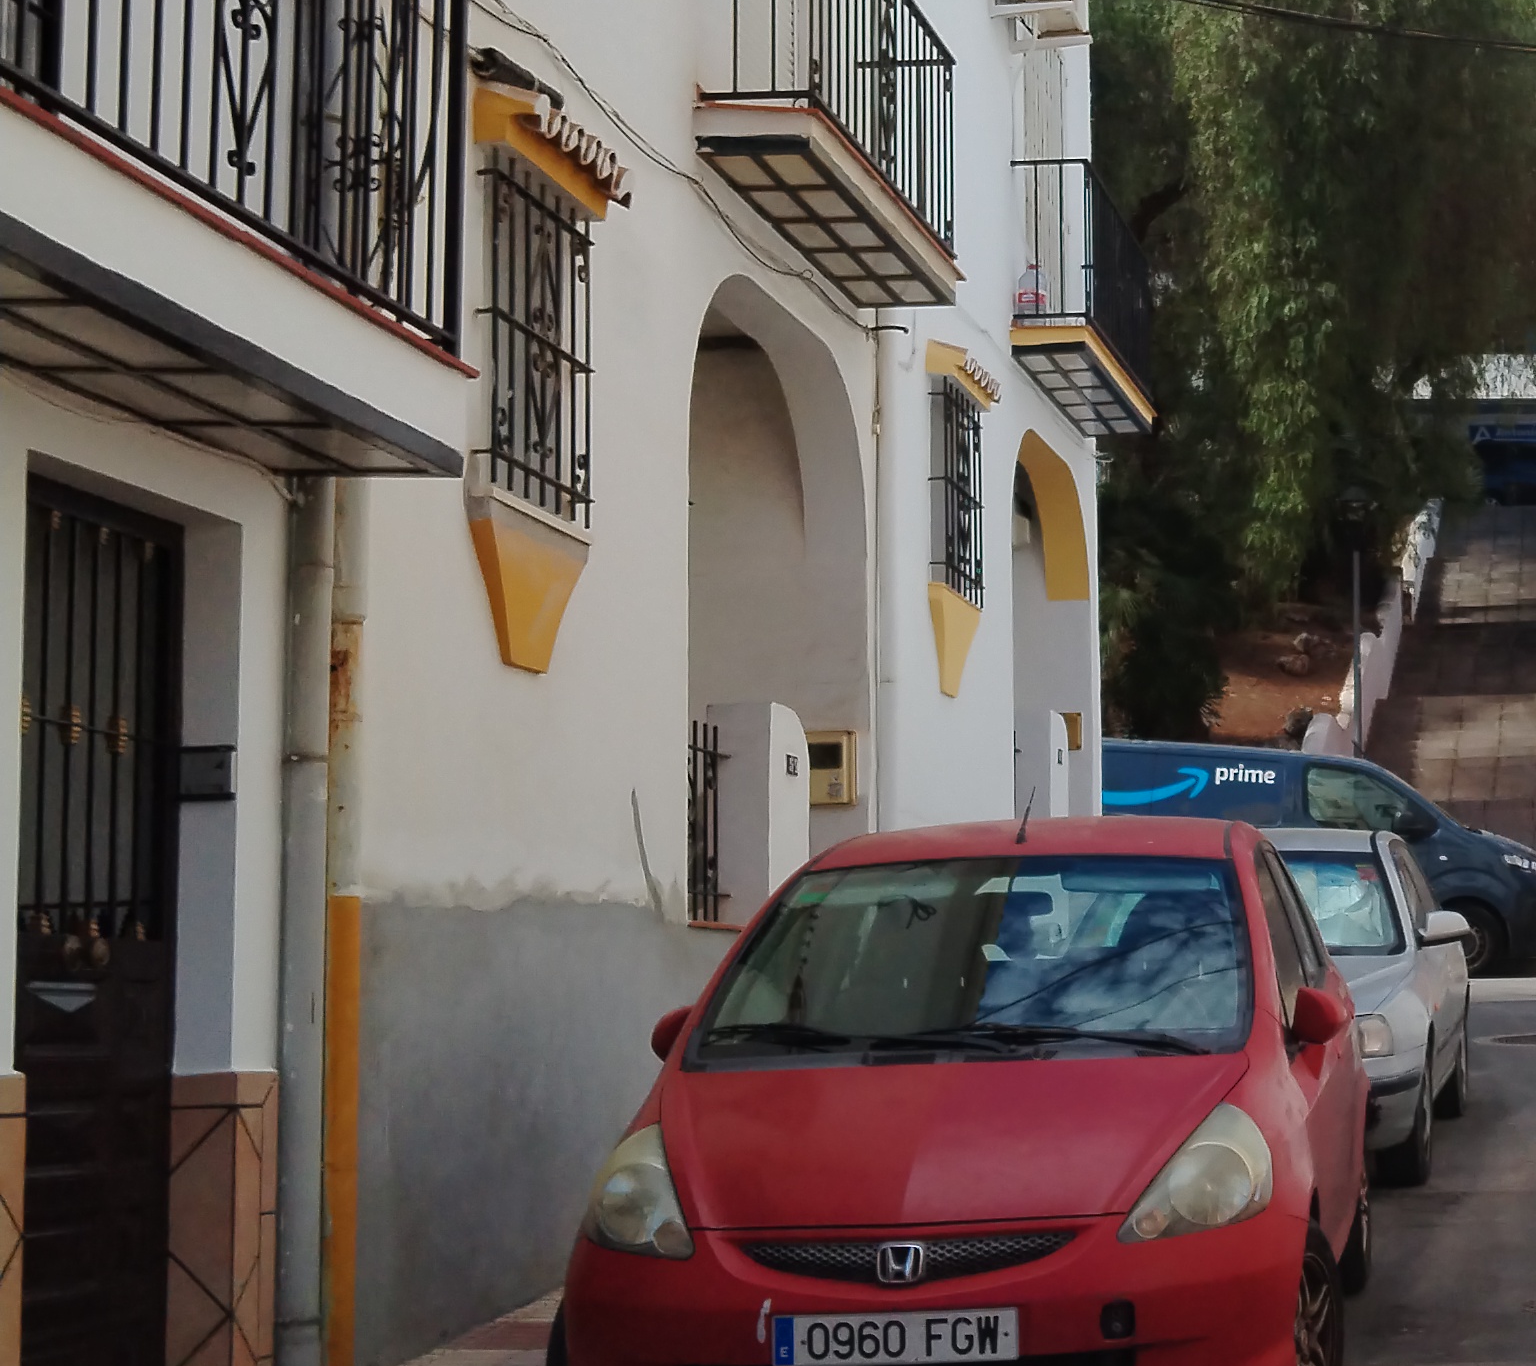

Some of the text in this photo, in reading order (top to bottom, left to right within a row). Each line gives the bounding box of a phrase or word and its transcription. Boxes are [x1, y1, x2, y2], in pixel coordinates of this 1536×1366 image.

[1214, 763, 1276, 786] prime
[806, 1315, 1000, 1361] 0960 FGW
